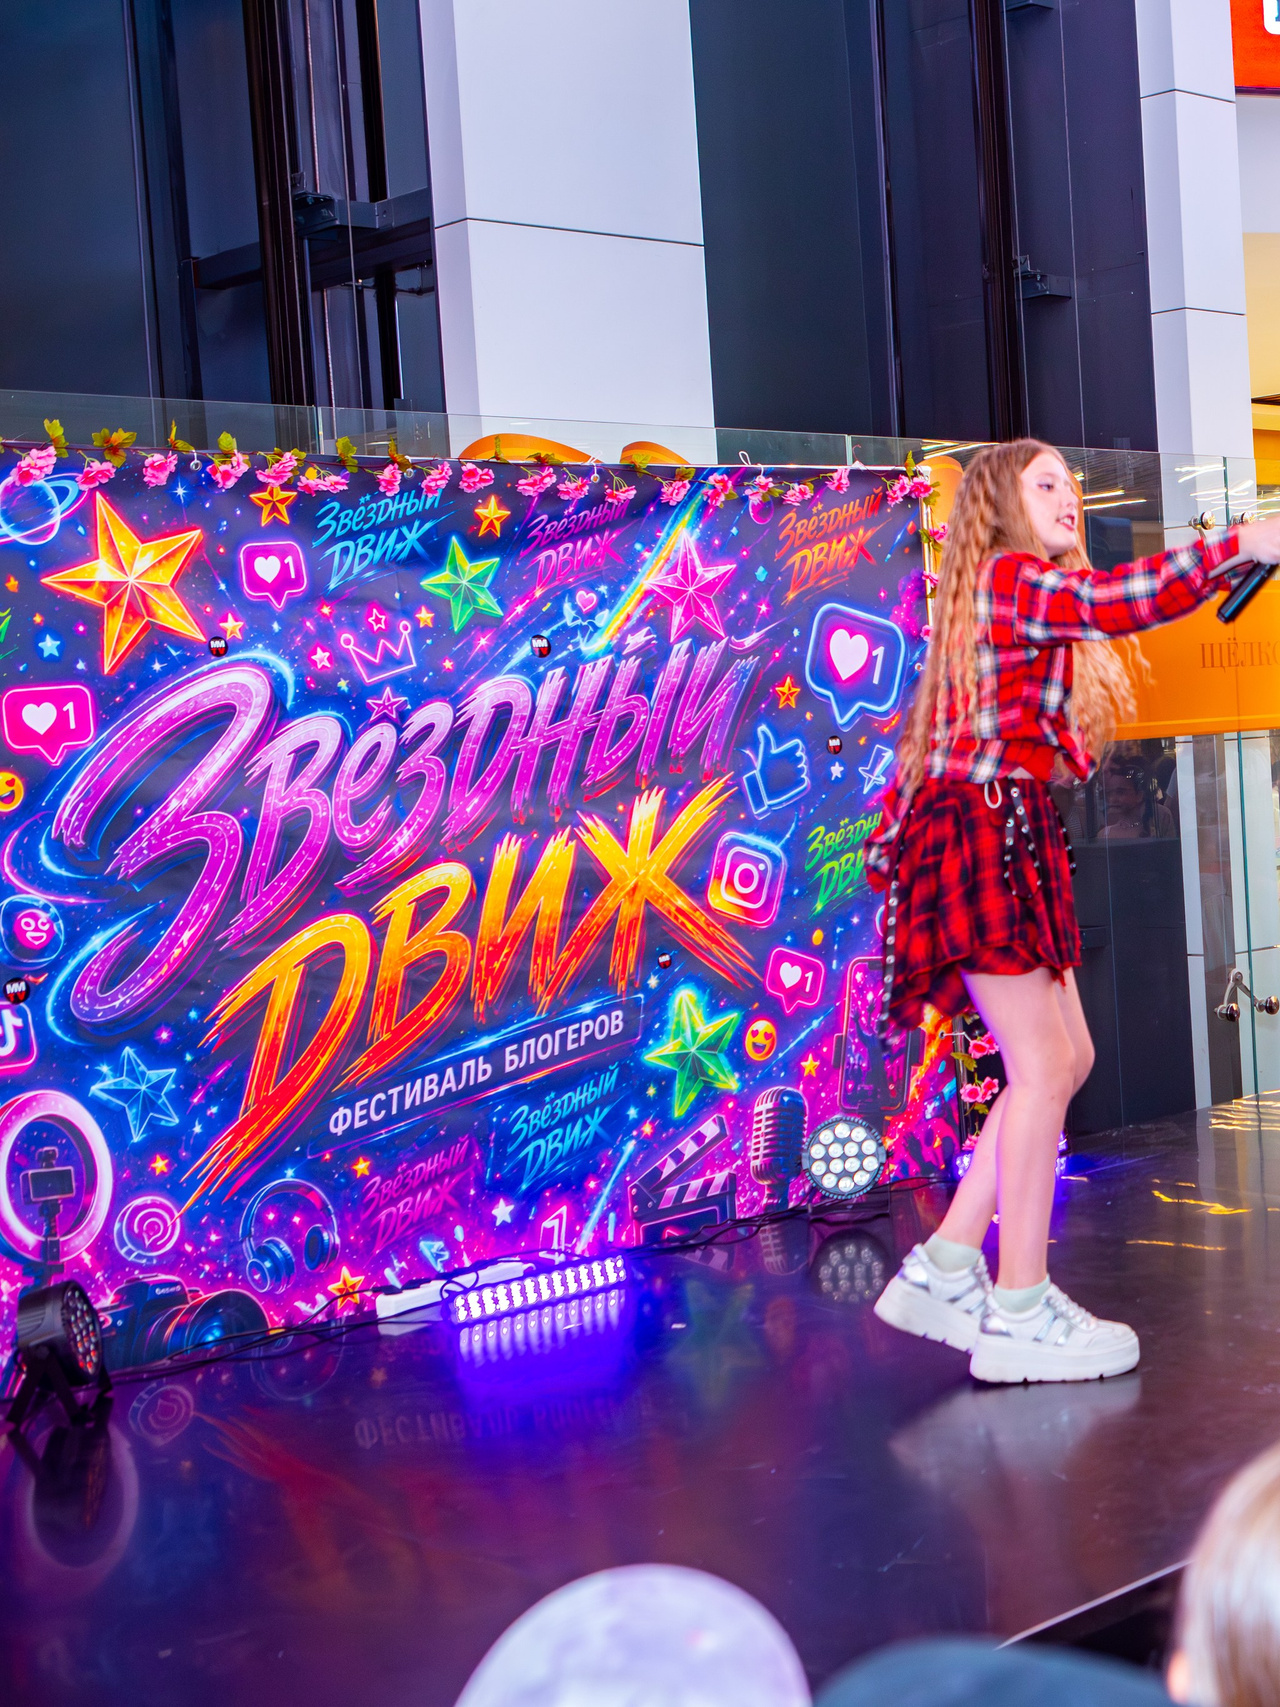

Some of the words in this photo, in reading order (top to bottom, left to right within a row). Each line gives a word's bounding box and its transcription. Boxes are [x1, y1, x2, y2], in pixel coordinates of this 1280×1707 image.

[284, 555, 297, 580] 1
[63, 701, 76, 730] 1
[180, 772, 766, 1210] ДВИЖ
[328, 1055, 493, 1137] ФЕСТИВАЛЬ
[504, 1008, 624, 1074] БЛОГЕРОВ
